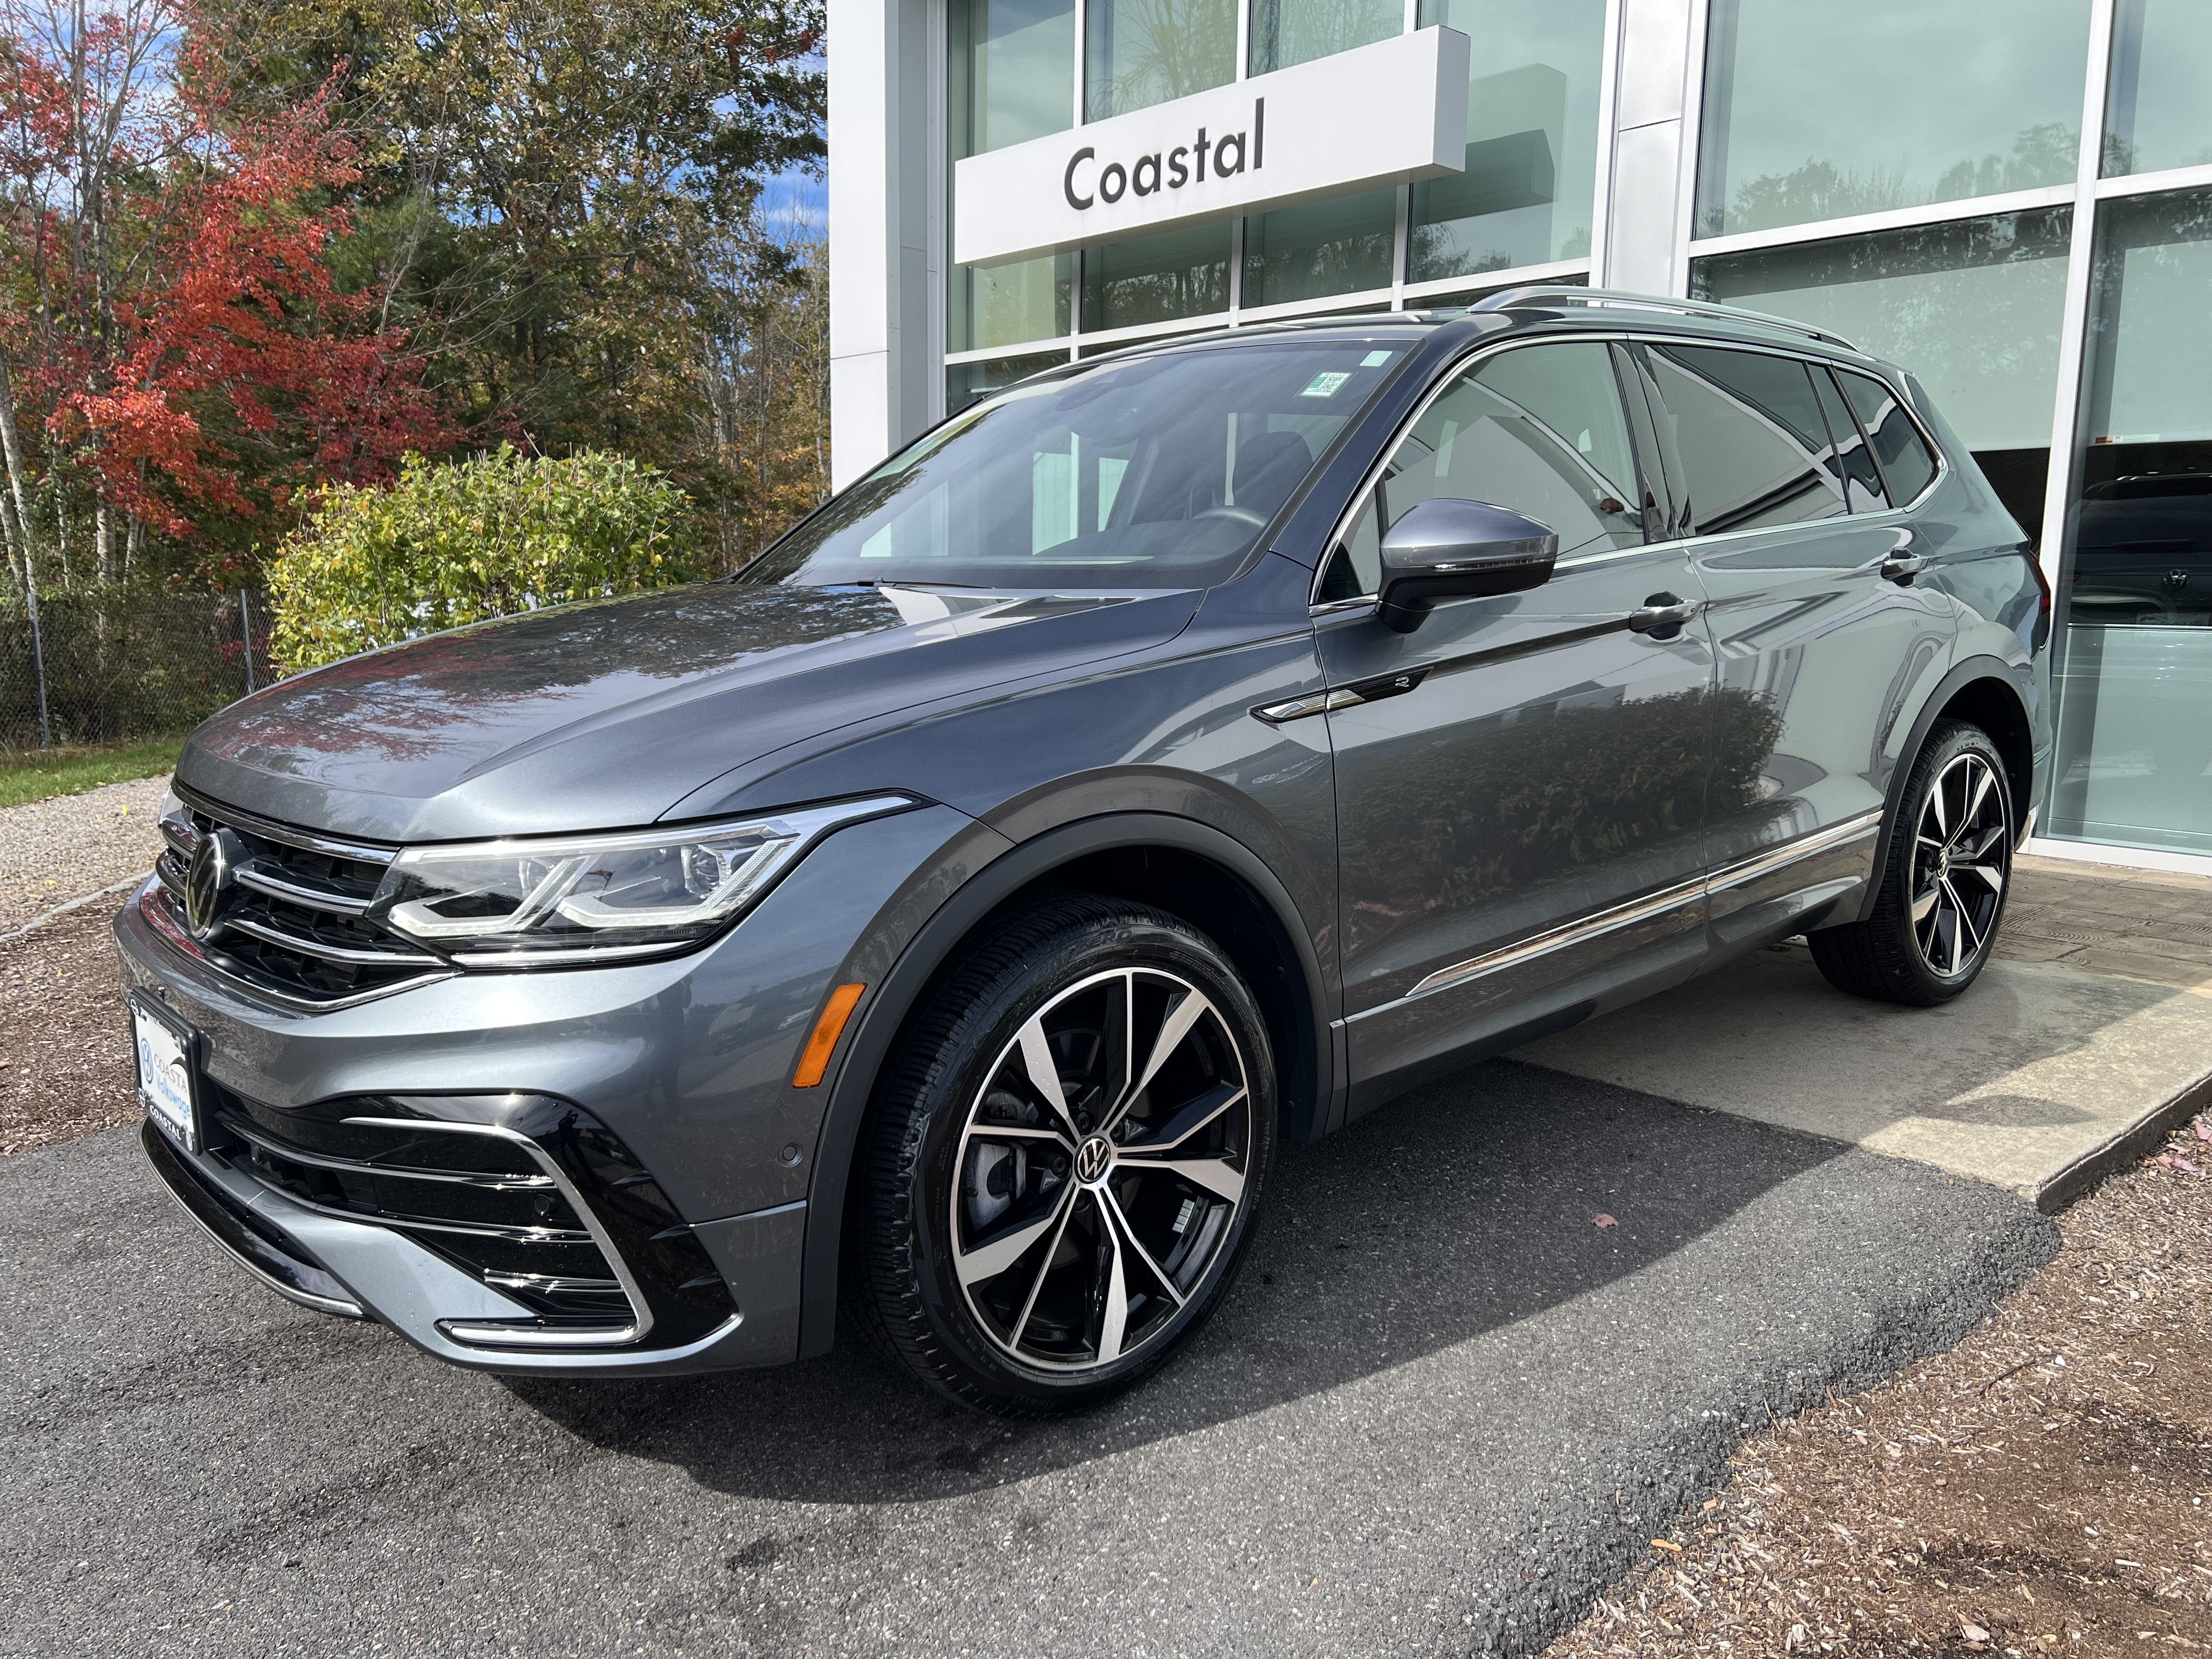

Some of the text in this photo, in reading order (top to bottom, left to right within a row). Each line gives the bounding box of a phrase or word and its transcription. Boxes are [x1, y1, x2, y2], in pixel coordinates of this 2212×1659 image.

[1064, 97, 1265, 210] Coastal
[154, 1054, 188, 1093] COASTA
[156, 1071, 190, 1120] Volkswage
[150, 1104, 182, 1141] COASTAL
[1077, 1137, 1110, 1184] VW
